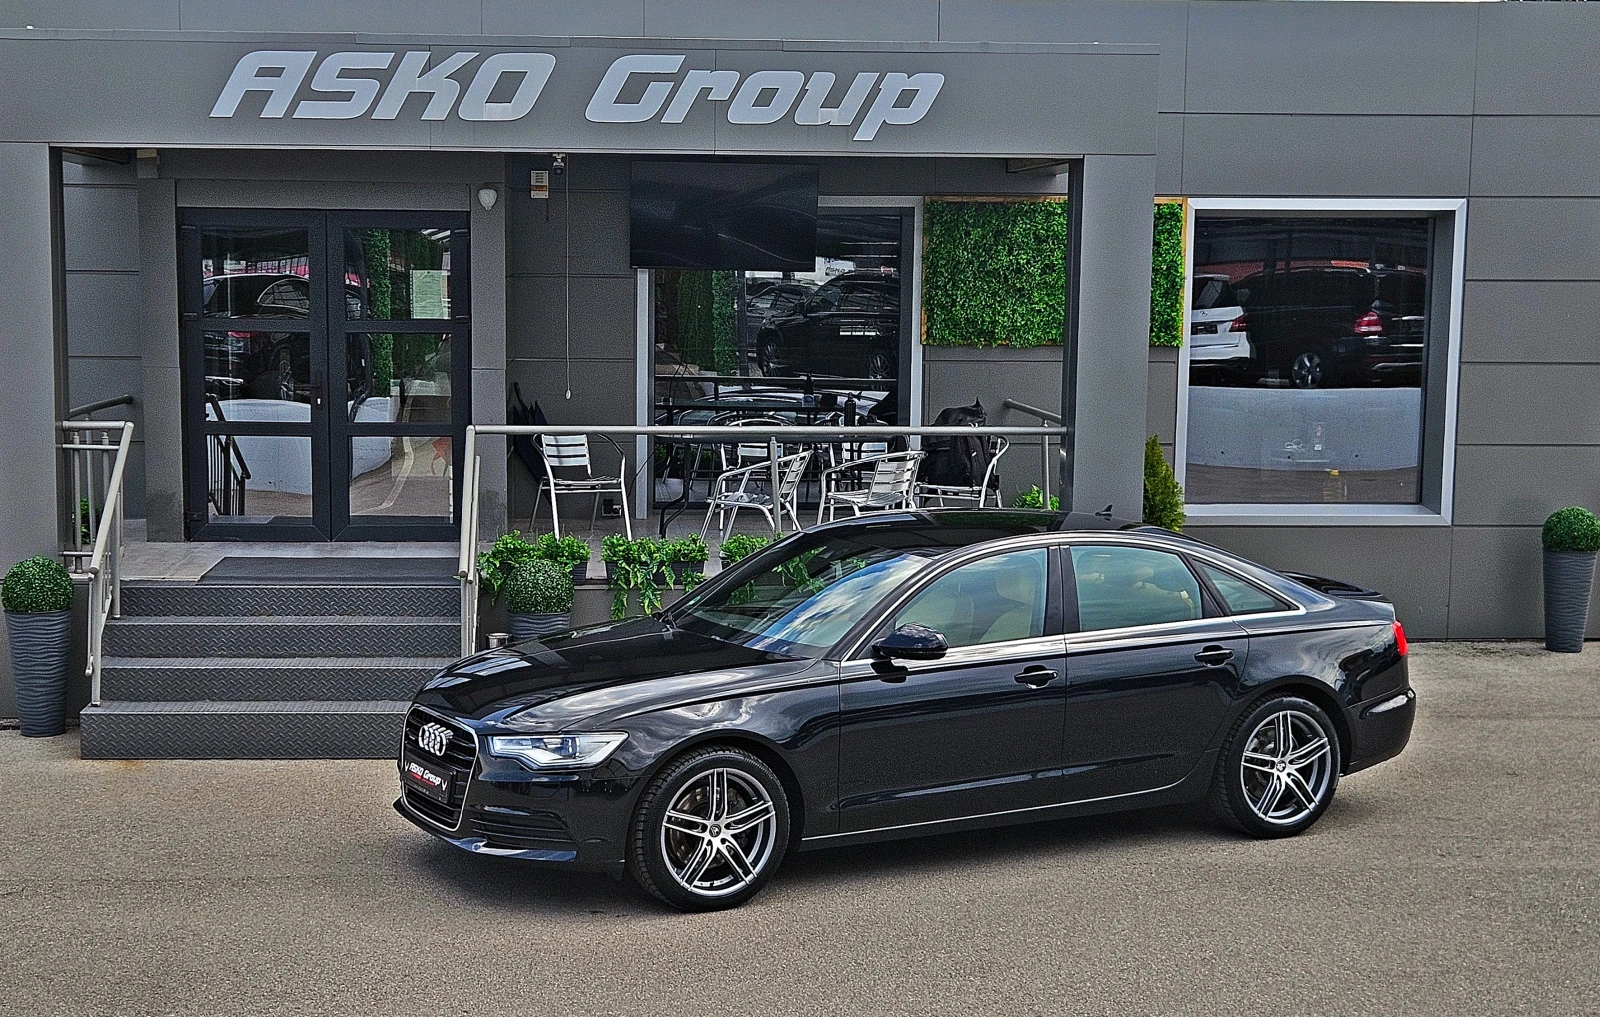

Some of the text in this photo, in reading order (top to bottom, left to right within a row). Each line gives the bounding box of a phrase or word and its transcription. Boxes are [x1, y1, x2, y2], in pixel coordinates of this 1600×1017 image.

[210, 51, 945, 141] ASKO Group
[409, 762, 442, 786] ASKO Group
